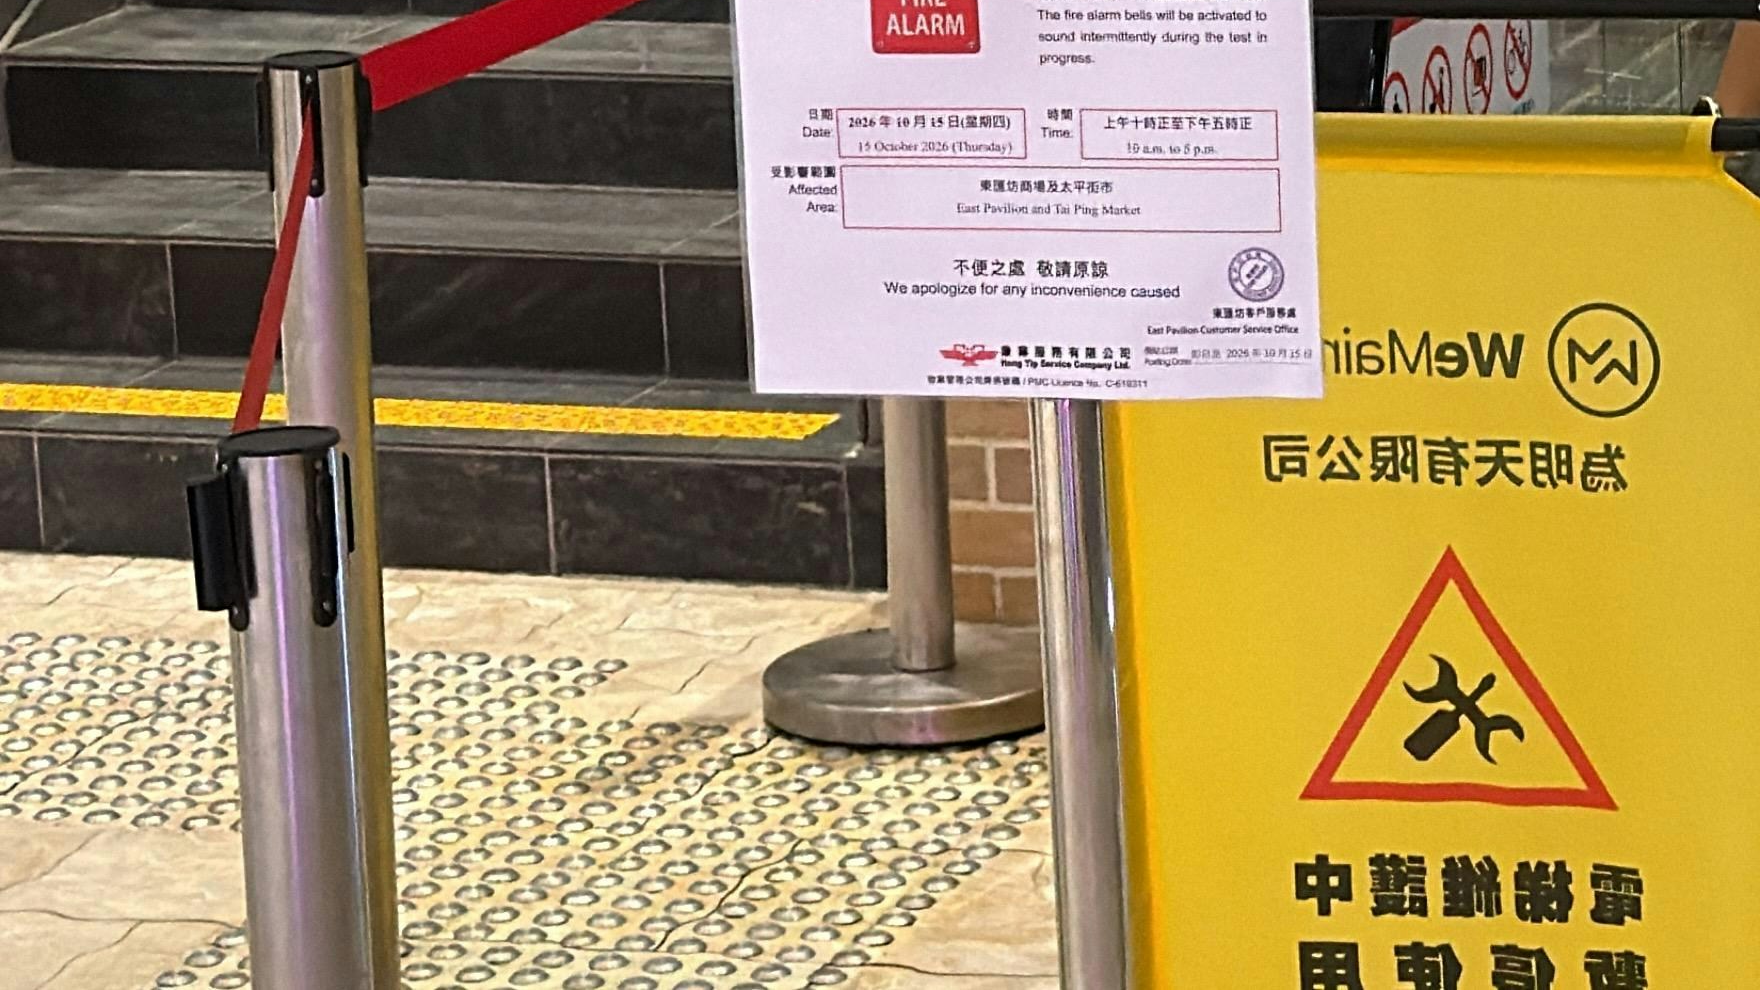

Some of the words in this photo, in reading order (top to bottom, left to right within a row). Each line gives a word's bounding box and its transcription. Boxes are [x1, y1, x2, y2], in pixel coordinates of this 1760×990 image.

[1038, 9, 1061, 21] The
[1064, 9, 1084, 21] fire
[1087, 9, 1121, 21] alarm
[1124, 9, 1152, 21] bells
[1156, 9, 1175, 21] will
[1179, 9, 1194, 21] be
[1198, 9, 1251, 21] activated
[1255, 10, 1267, 21] to
[887, 13, 965, 37] ALARM
[1038, 31, 1075, 42] sound
[1081, 31, 1157, 45] intermittently
[1162, 31, 1200, 45] during
[1205, 31, 1224, 43] the
[1229, 32, 1251, 43] test
[1257, 32, 1268, 43] in
[1039, 53, 1095, 66] progress.
[808, 108, 834, 121] 日期
[1047, 108, 1073, 121] 時間
[913, 115, 926, 129] 月
[1103, 116, 1253, 131] 上午十時正至下午五時正
[788, 183, 838, 195] Affected
[953, 259, 1025, 277] 不便之處
[1036, 260, 1109, 278] 敬請原諒
[884, 281, 908, 295] We
[911, 281, 977, 299] apologize
[980, 282, 999, 296] for
[1003, 284, 1027, 299] any
[1031, 283, 1127, 298] inconvenience
[1131, 284, 1181, 298] caused
